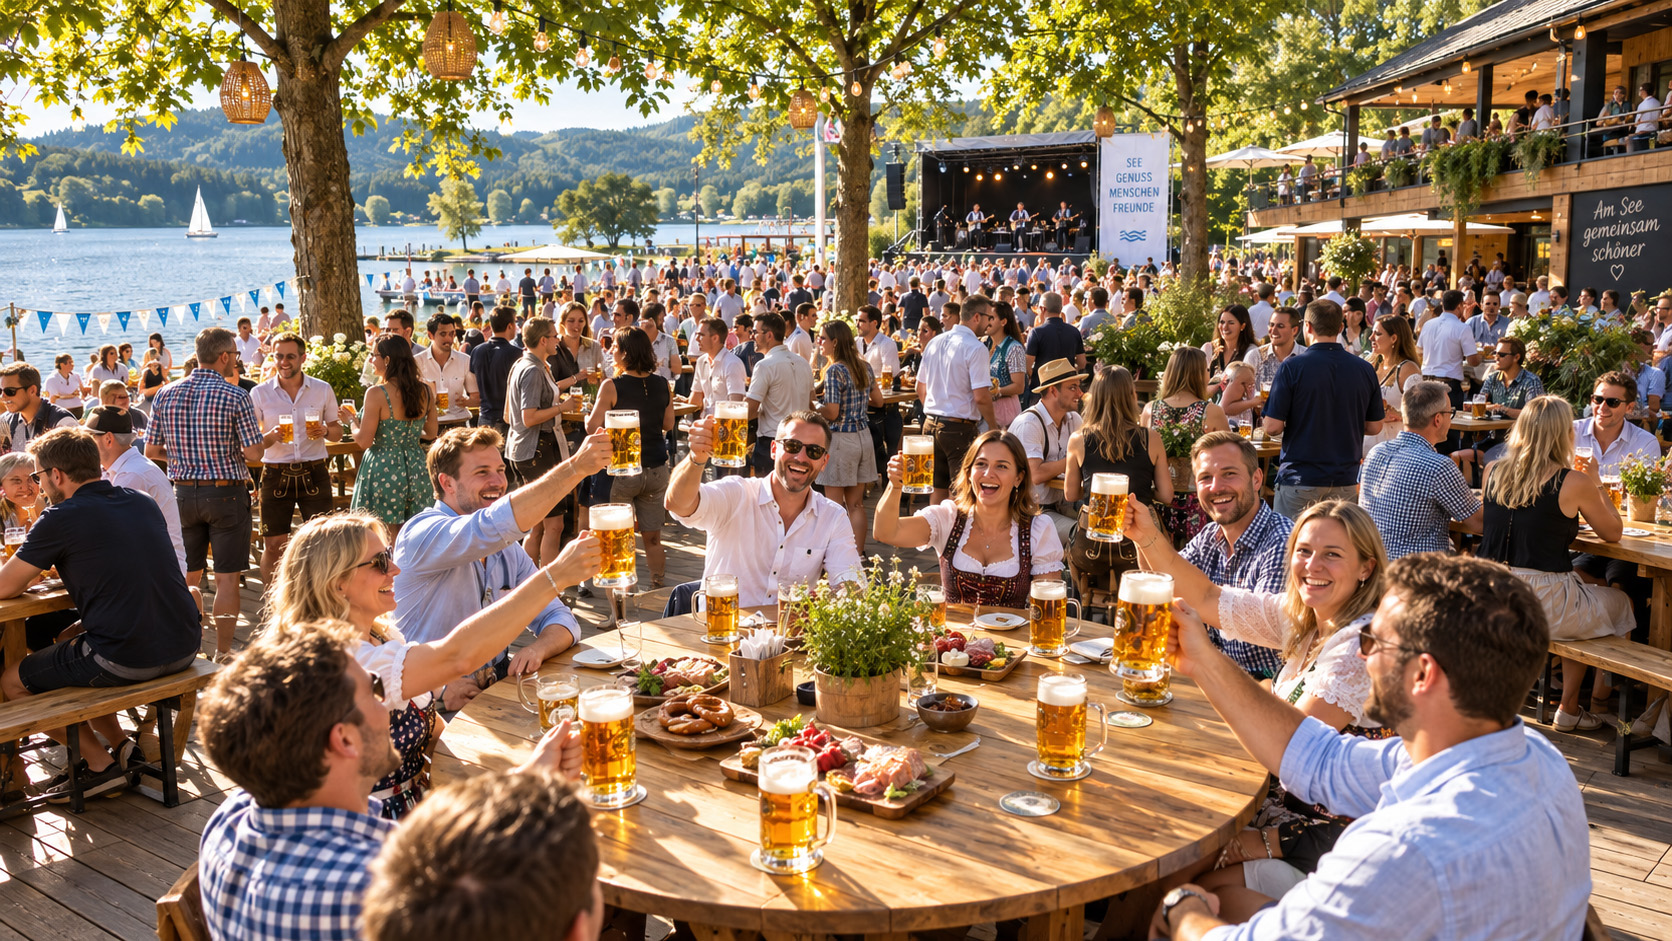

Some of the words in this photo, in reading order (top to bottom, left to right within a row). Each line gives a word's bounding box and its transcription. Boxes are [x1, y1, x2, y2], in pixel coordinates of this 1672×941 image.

[1126, 157, 1143, 168] SEE
[1115, 171, 1153, 183] GENUSS
[1109, 186, 1160, 198] MENSCHEN
[1112, 201, 1155, 213] FREUNDE
[1593, 199, 1616, 220] Am
[1619, 196, 1645, 216] See
[1582, 218, 1661, 248] gemeinsam
